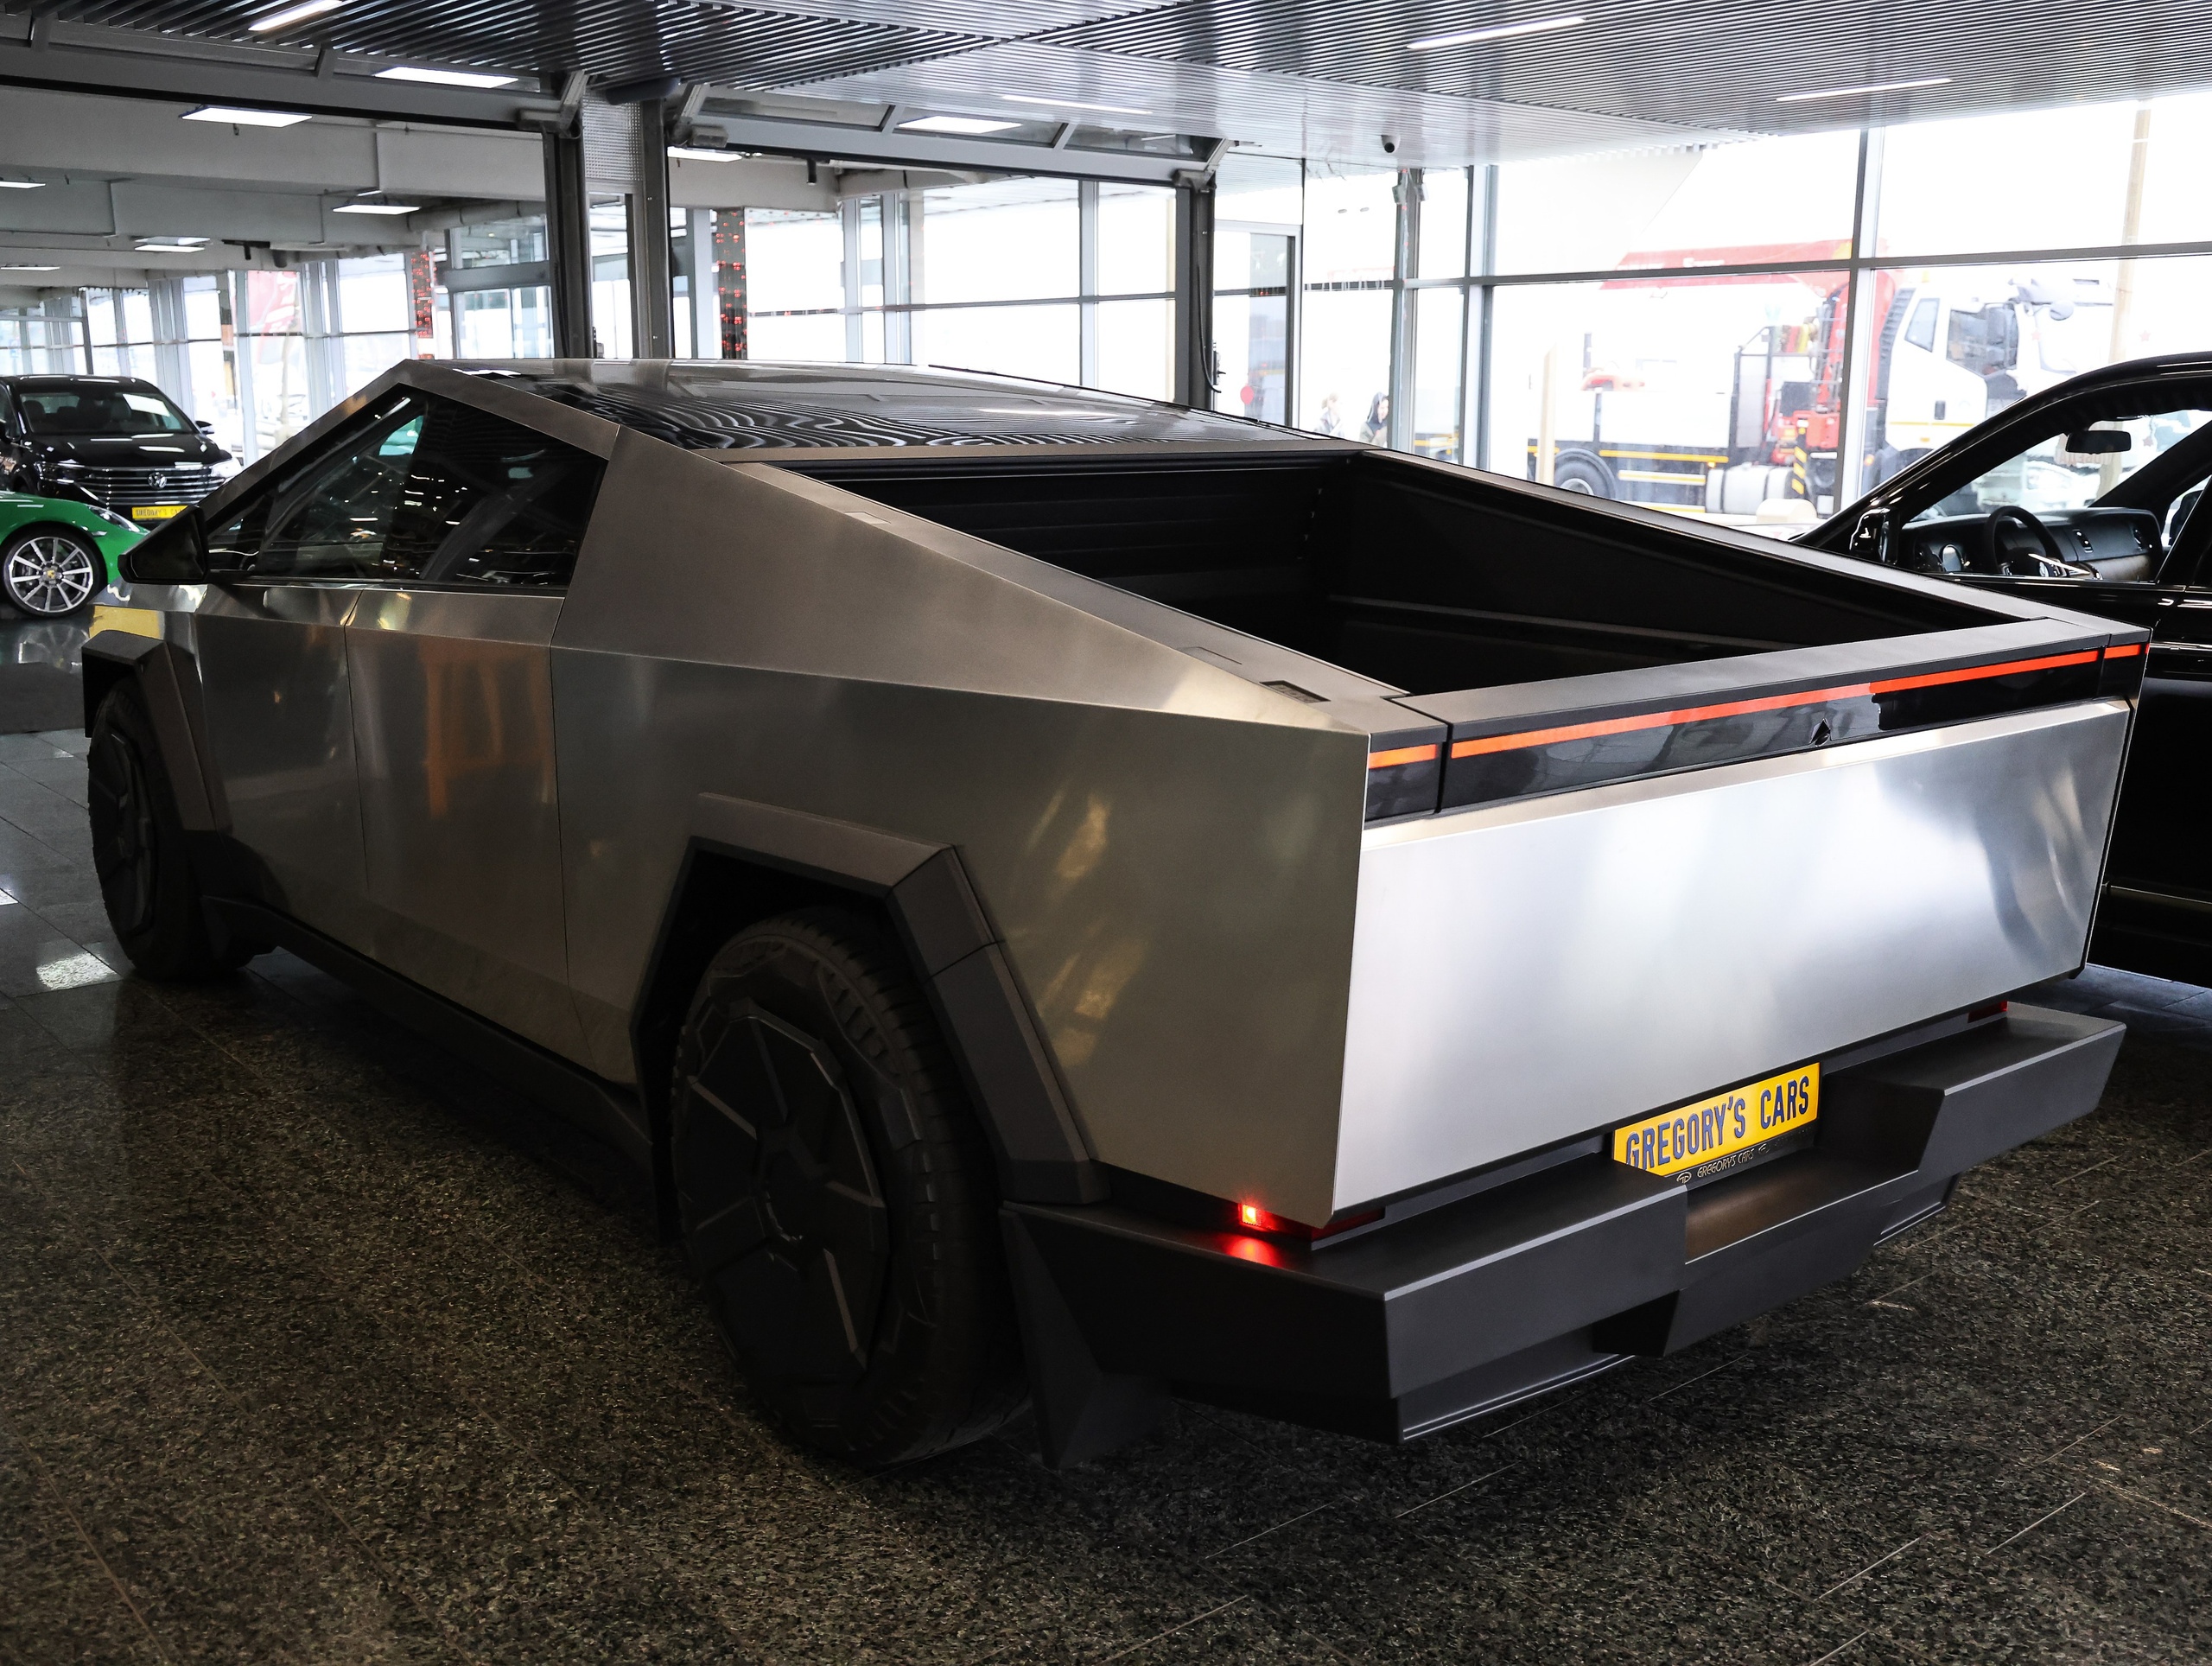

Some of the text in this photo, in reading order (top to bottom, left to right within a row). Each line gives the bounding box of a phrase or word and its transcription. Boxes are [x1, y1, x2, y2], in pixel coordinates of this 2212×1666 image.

[1626, 1075, 1809, 1170] GREGORY'S CARS
[1738, 1149, 1754, 1164] CARS
